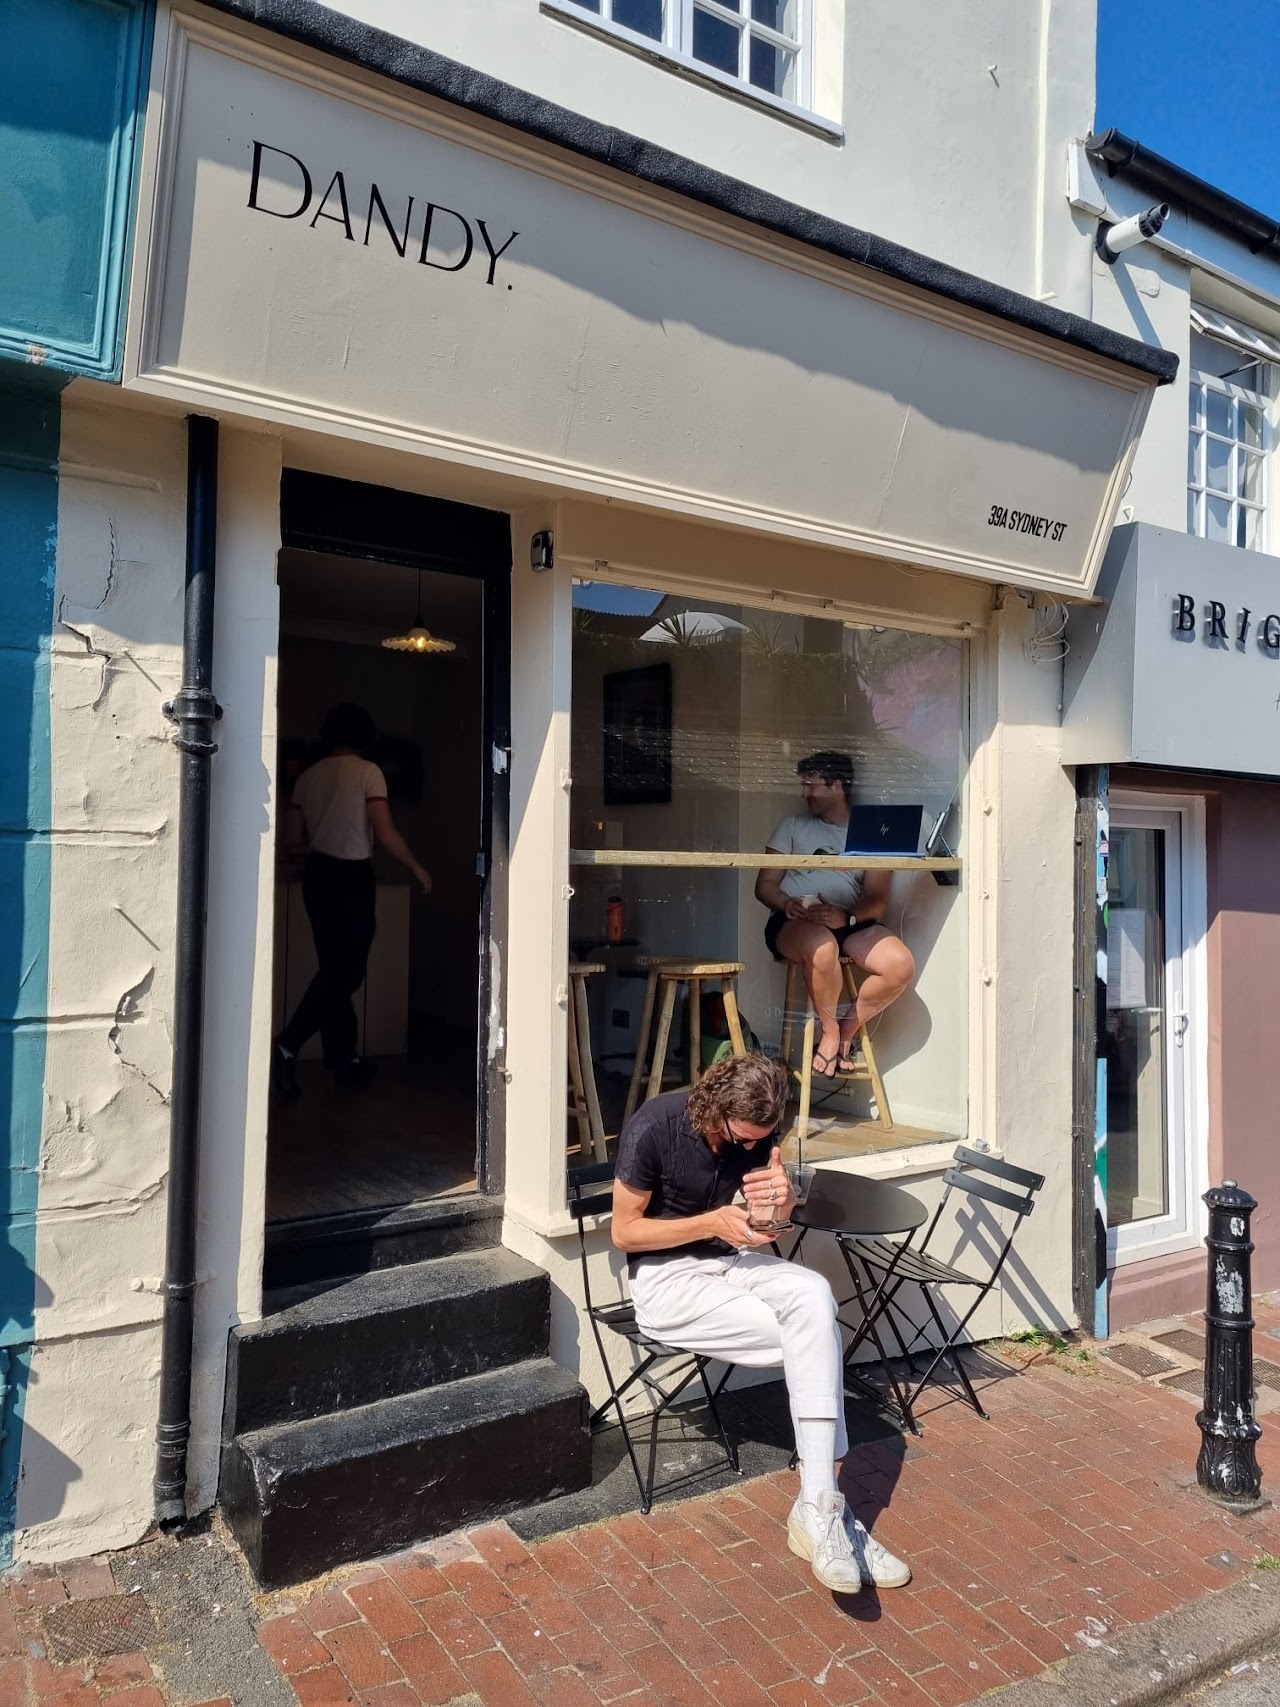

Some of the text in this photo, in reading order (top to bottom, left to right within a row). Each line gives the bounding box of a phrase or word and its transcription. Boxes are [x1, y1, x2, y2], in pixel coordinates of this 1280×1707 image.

[247, 139, 520, 291] DANDY.
[987, 504, 1068, 542] 39A SYDNEY ST
